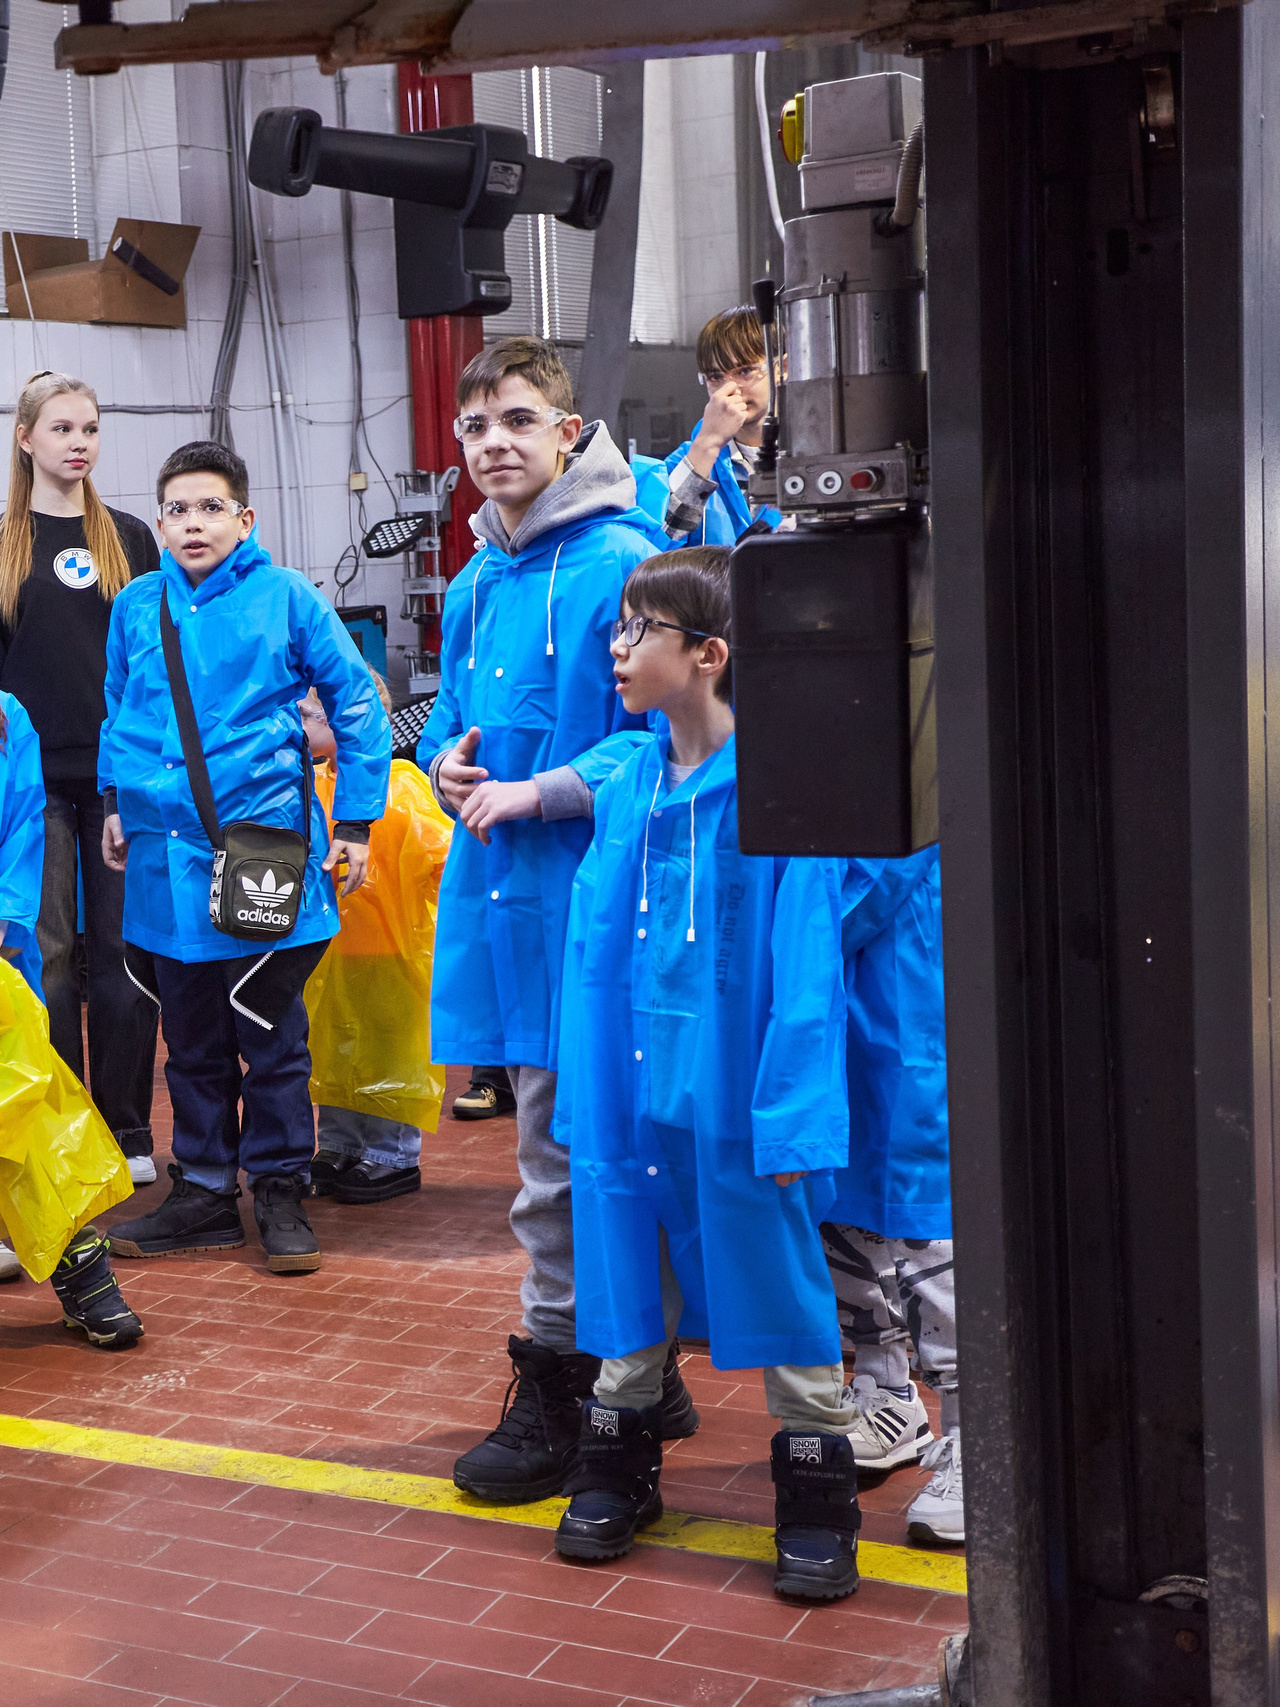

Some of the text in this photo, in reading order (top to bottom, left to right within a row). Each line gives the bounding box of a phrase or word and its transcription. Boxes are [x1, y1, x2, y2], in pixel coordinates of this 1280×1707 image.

[60, 552, 91, 561] BMW
[237, 908, 290, 926] adidas
[594, 1409, 616, 1421] SNOW
[793, 1440, 817, 1448] SNOW
[793, 1448, 819, 1456] FASHION
